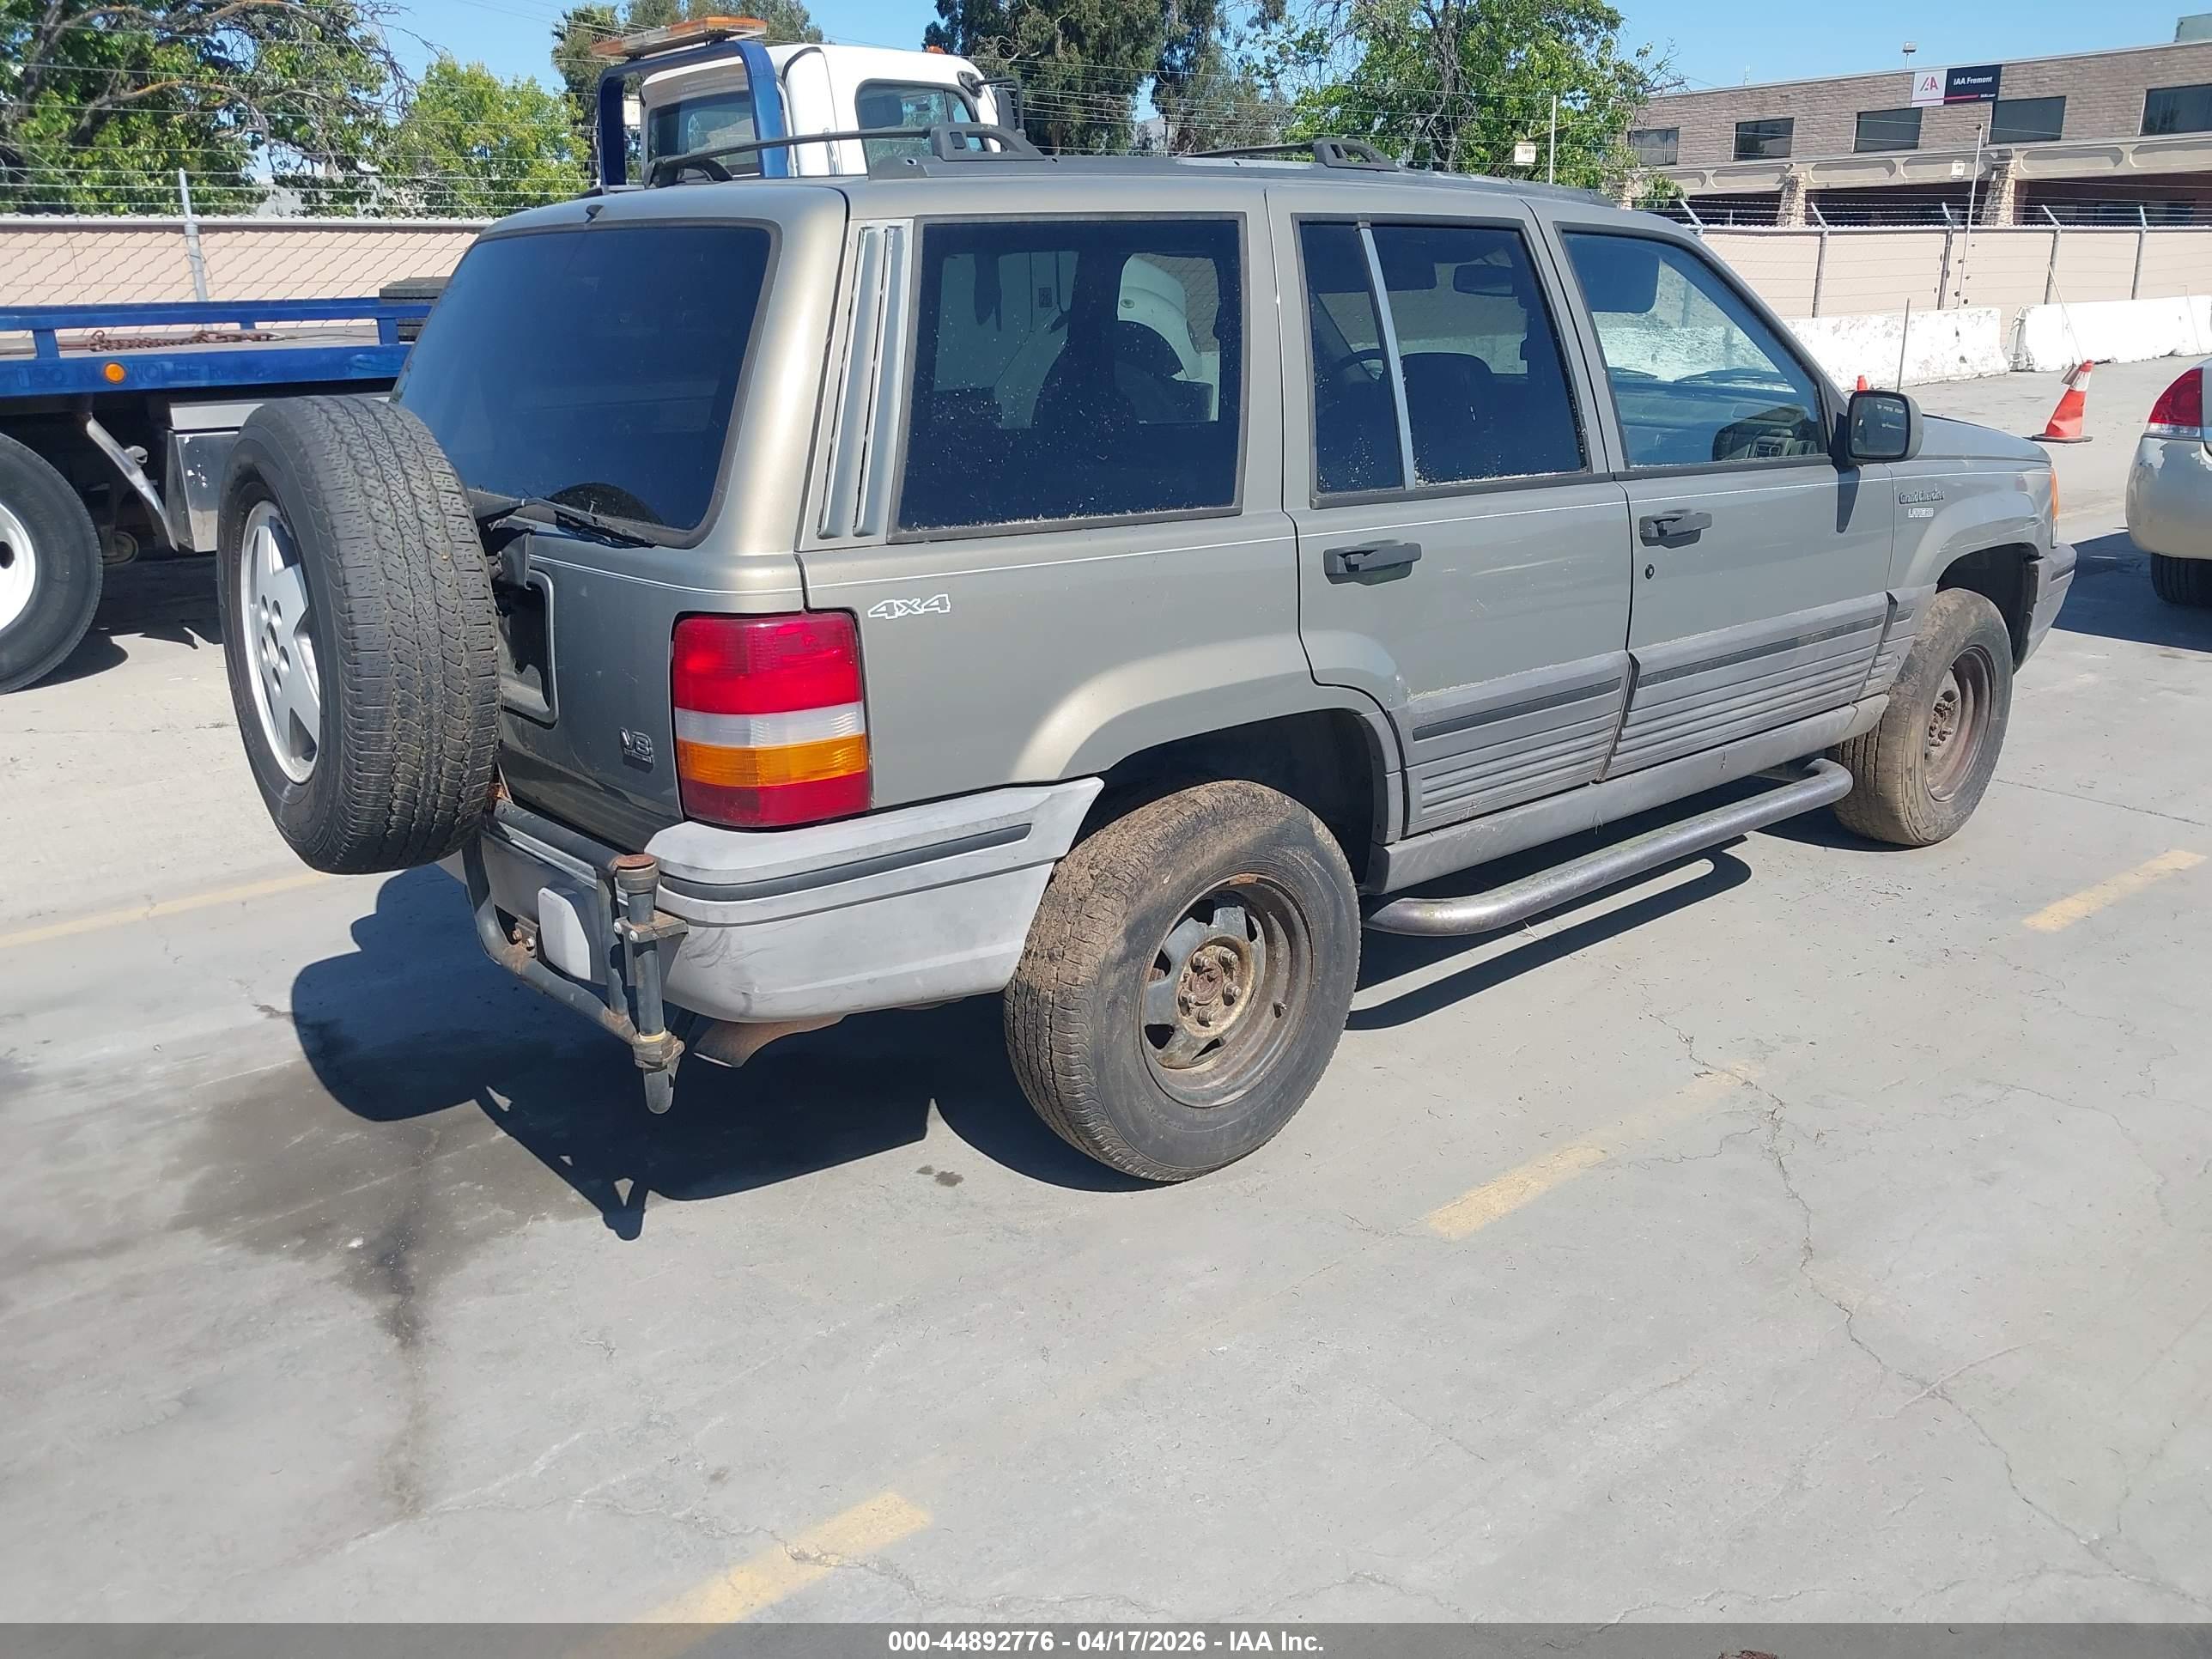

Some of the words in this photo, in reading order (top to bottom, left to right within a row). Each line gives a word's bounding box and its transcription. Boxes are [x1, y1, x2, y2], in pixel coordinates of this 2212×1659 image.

[1954, 76, 1966, 86] IAA
[1966, 76, 1993, 85] Fremont
[619, 726, 653, 756] V8
